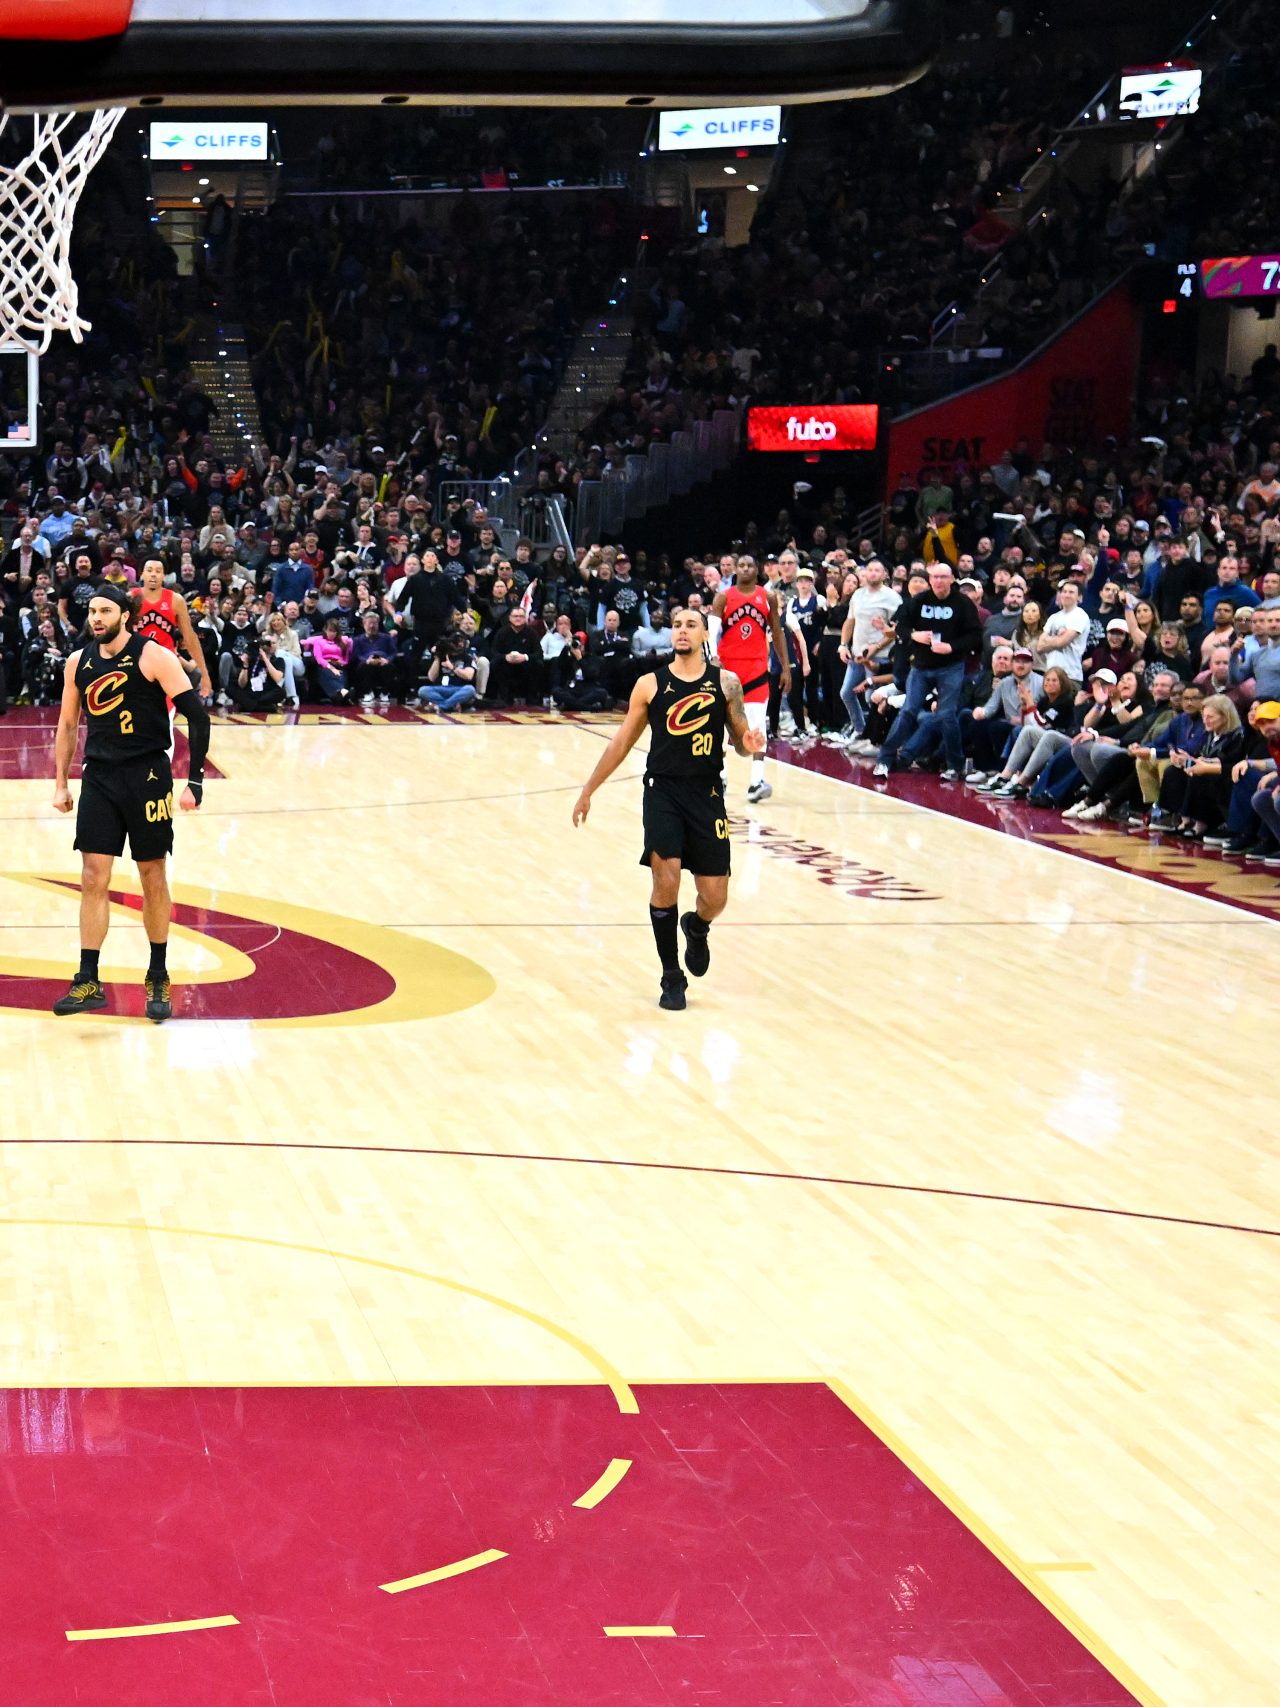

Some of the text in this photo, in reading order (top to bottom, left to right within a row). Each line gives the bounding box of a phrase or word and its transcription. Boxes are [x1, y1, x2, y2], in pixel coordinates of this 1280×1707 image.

[705, 118, 775, 135] CLIFFS
[194, 135, 262, 147] CLIFFS
[1179, 277, 1193, 297] 4
[1260, 261, 1280, 290] 7
[786, 416, 837, 440] fubo
[921, 436, 987, 462] SEAT
[740, 622, 752, 640] 9
[119, 710, 134, 734] 2
[691, 733, 713, 756] 20
